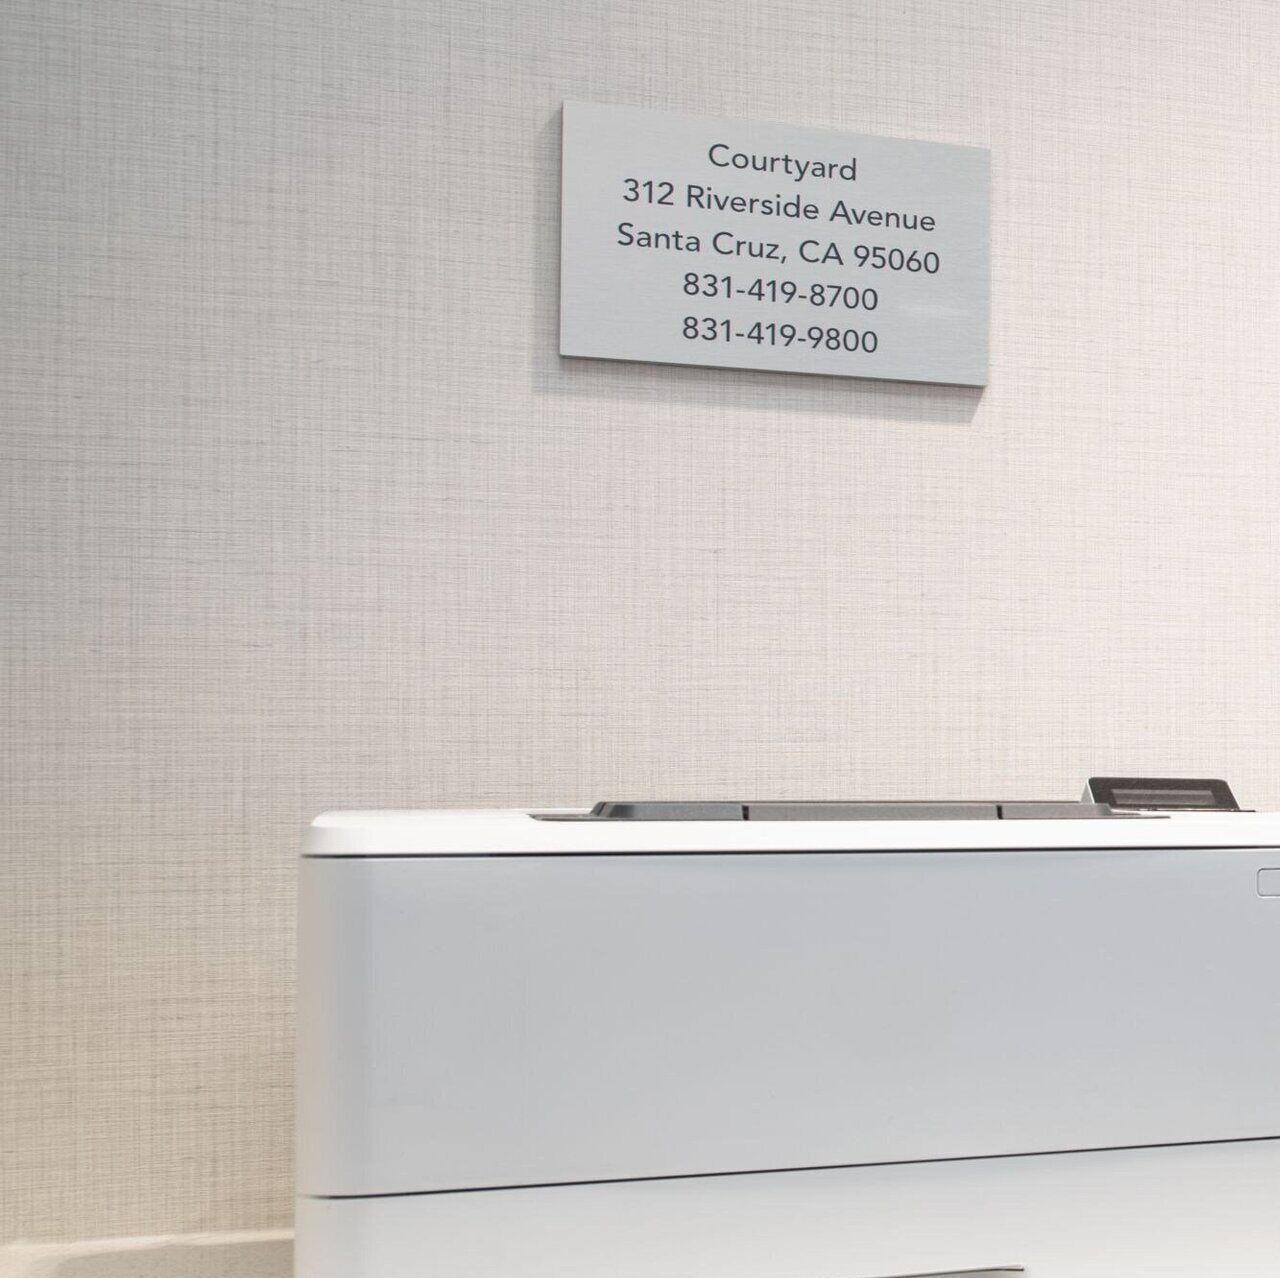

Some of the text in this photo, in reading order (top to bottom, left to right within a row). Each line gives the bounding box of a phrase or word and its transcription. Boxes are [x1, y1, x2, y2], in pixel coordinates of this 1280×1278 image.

[708, 143, 857, 182] Courtyard
[623, 178, 936, 232] 312 Riverside Avenue
[617, 222, 940, 274] Santa Cruz, CA 95060
[683, 272, 878, 311] 831-419-8700
[682, 316, 878, 353] 831-419-9800
